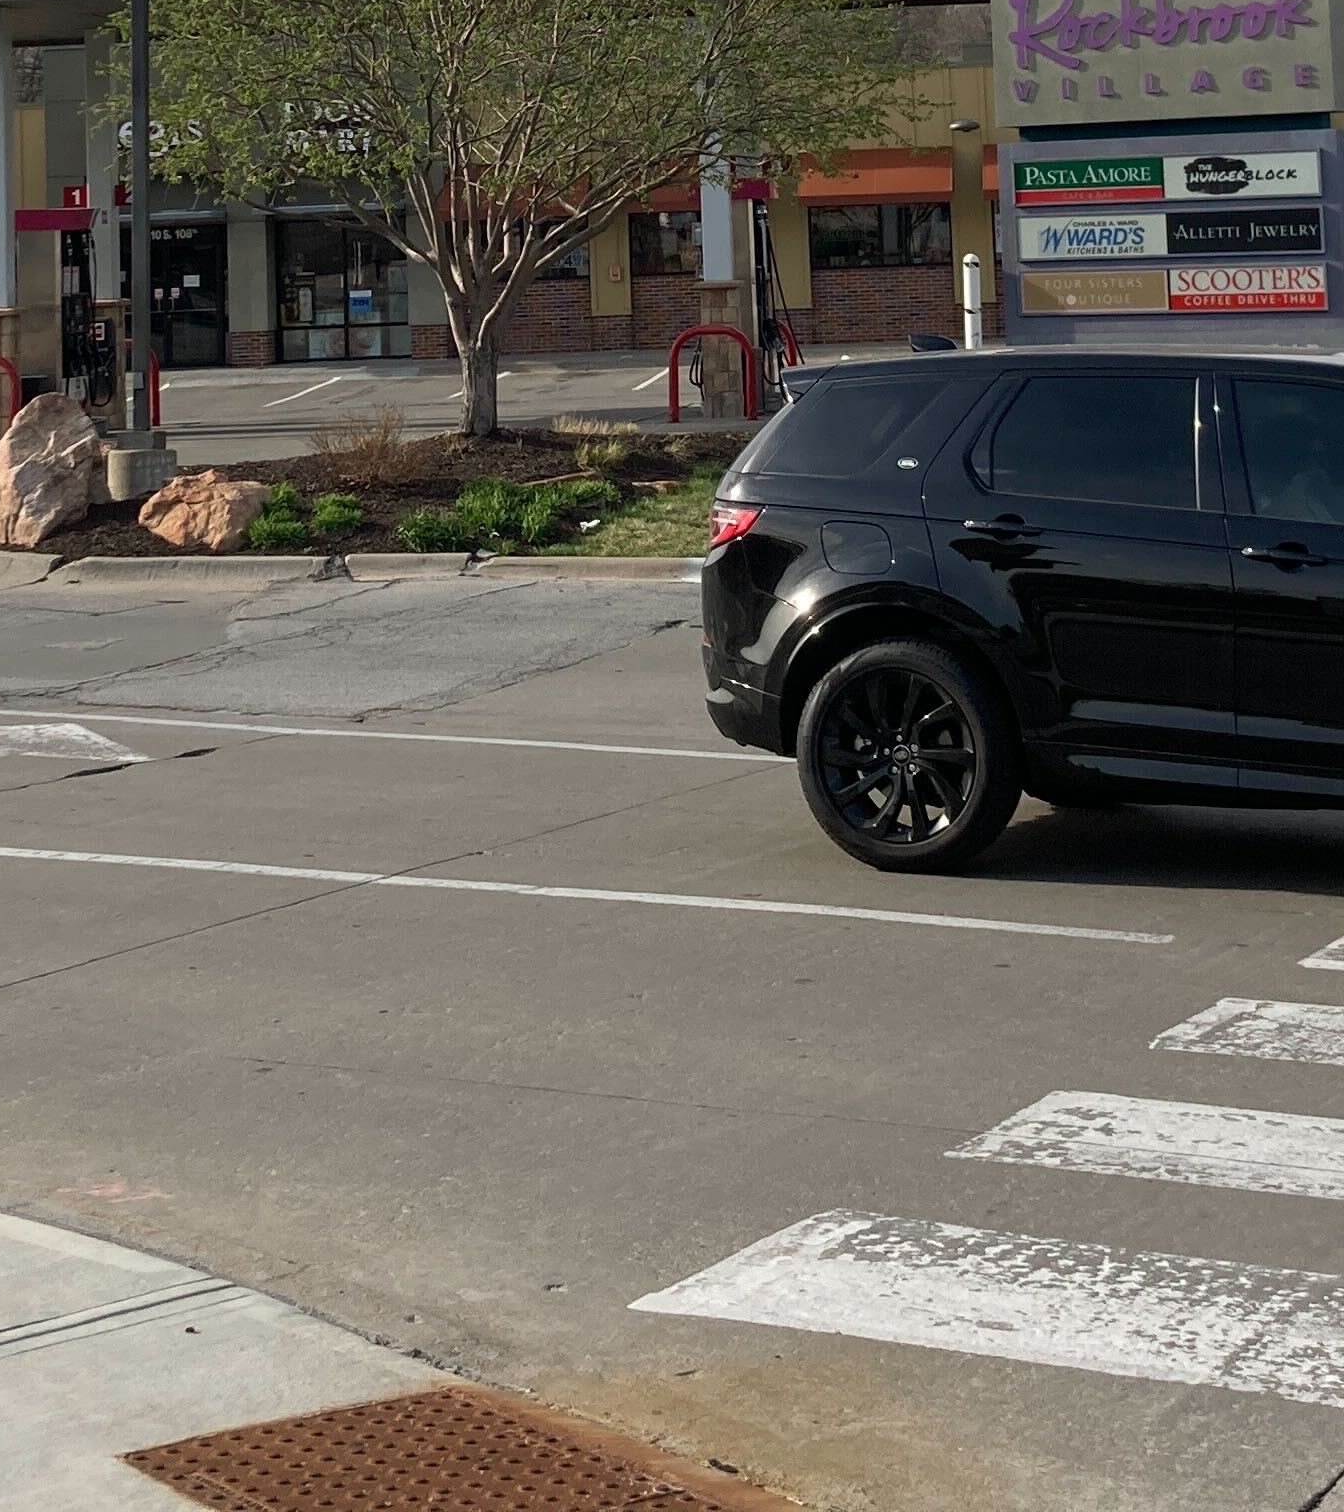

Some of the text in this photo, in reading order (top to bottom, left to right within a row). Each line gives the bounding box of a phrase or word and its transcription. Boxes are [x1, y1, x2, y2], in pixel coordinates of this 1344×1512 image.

[1013, 64, 1316, 101] VILLAGE
[1024, 164, 1151, 185] PASTA AMORE
[71, 189, 81, 205] 1
[1067, 227, 1145, 246] WARD'S
[1067, 247, 1107, 255] KITCHENS
[1118, 246, 1144, 254] BATHS
[1045, 278, 1143, 289] FOUR SISTERS
[1178, 267, 1321, 292] SCOOTER'S
[1184, 294, 1316, 306] COFFEE DRIVE-THRU
